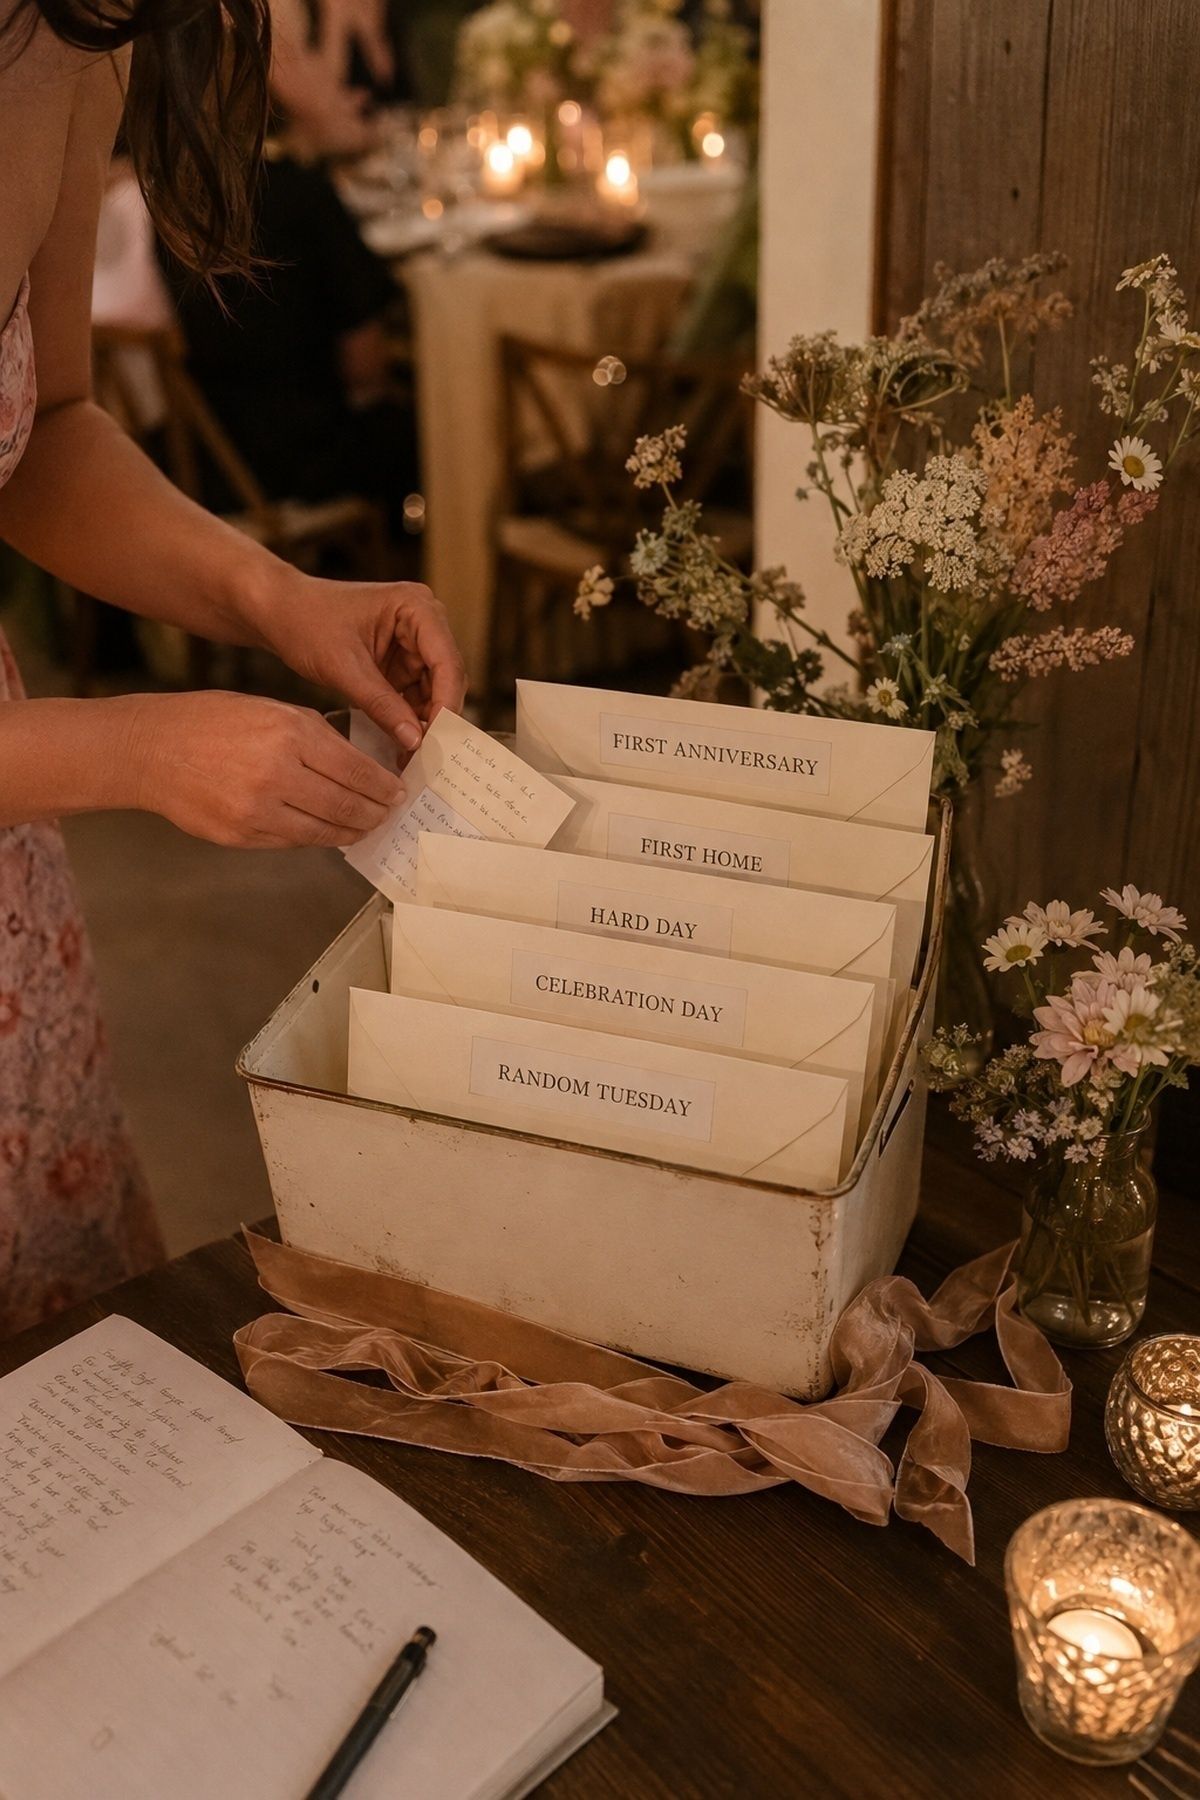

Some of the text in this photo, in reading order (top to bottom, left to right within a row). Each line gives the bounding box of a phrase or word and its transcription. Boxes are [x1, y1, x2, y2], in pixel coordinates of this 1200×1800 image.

[613, 733, 818, 775] FIRST ANNIVERSARY
[640, 838, 762, 872] FIRST HOME
[590, 907, 697, 939] HARD DAY
[536, 974, 723, 1022] CELEBRATION DAY
[498, 1064, 692, 1117] RANDOM TUESDAY
